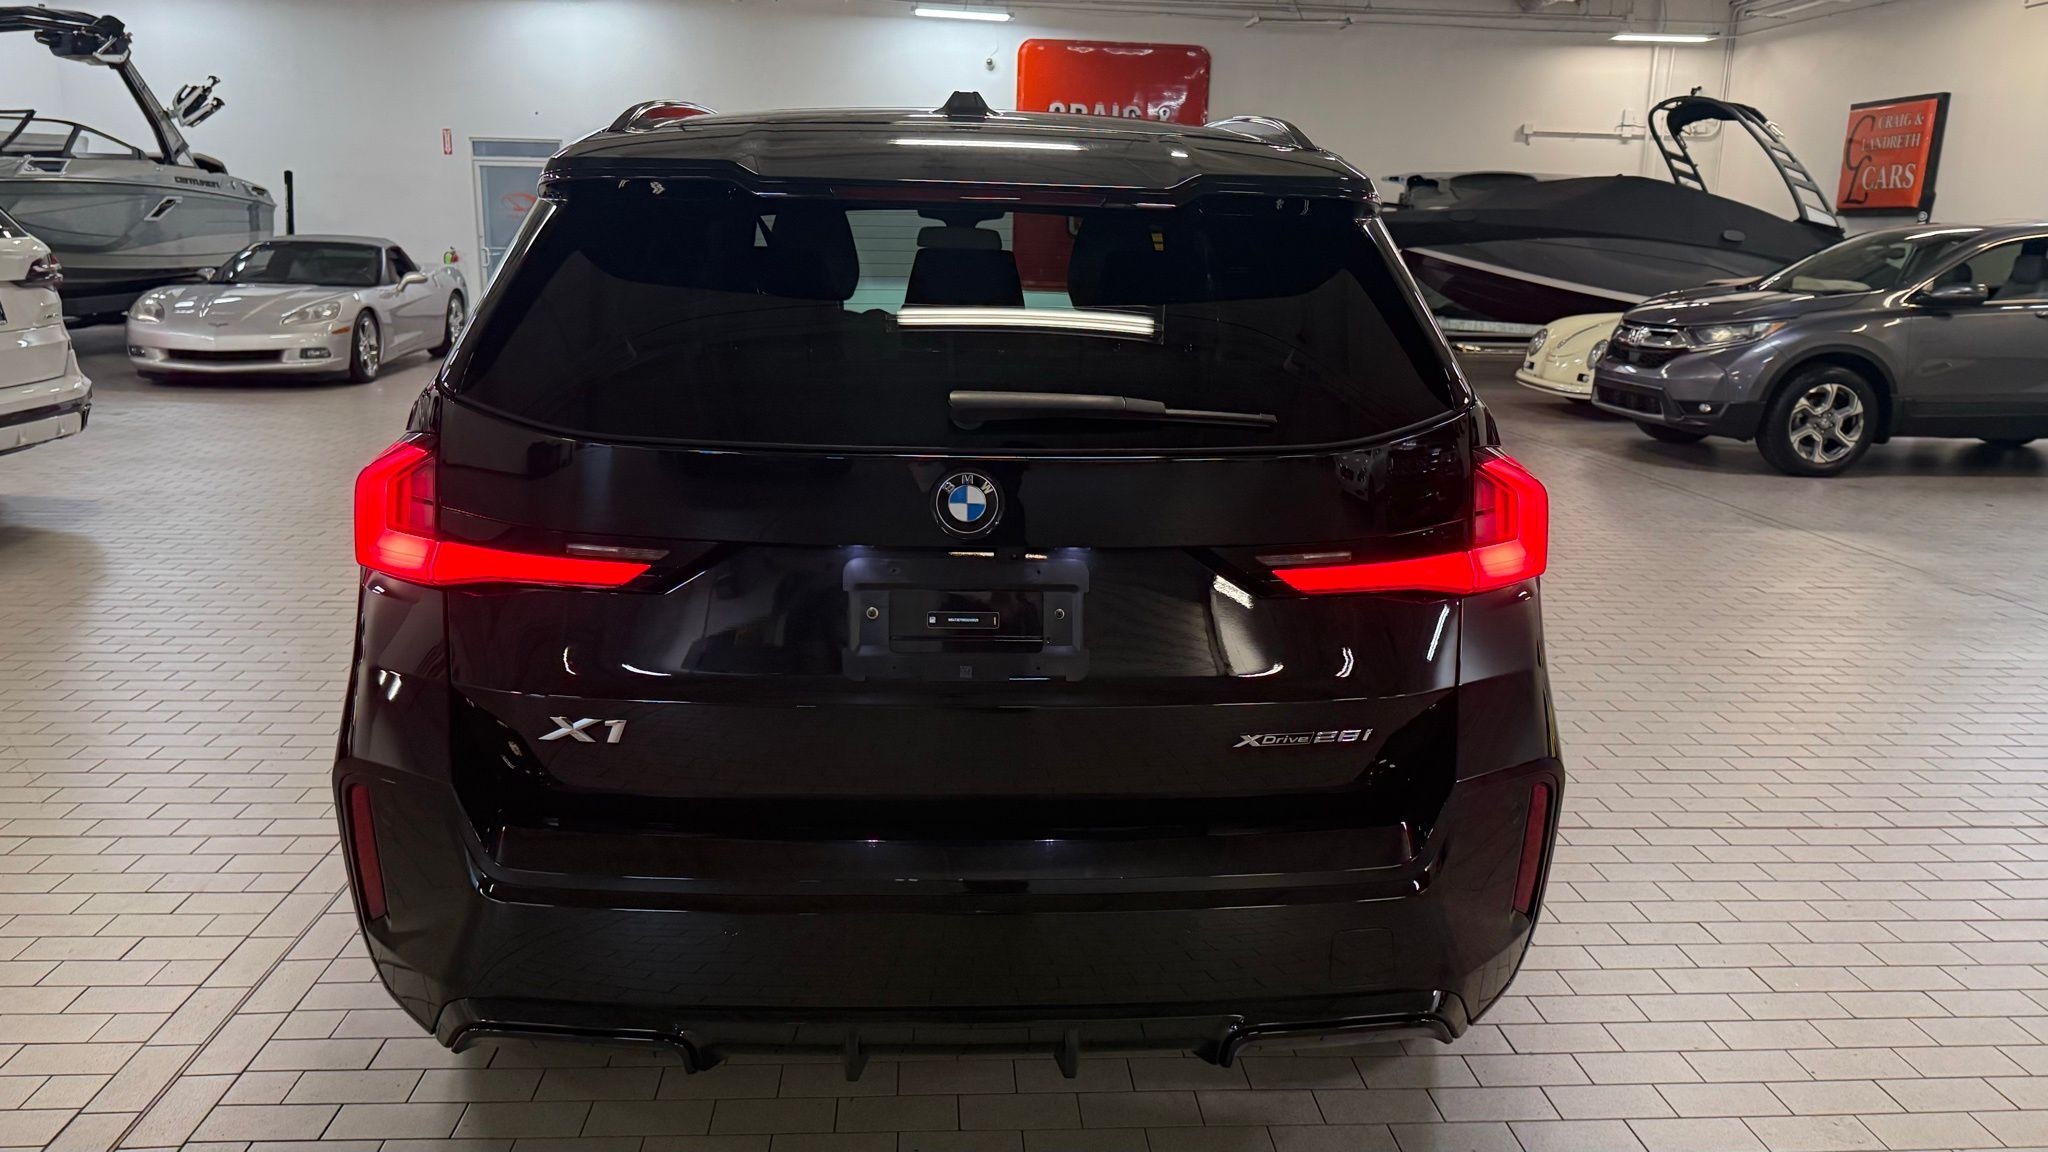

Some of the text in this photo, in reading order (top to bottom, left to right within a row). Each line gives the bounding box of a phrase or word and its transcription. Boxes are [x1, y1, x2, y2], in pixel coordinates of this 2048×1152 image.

[1878, 112, 1924, 129] CRAIG &
[1861, 133, 1921, 151] LANDRETH
[1862, 163, 1916, 190] CARS
[942, 475, 994, 495] BMW
[538, 716, 627, 743] X1
